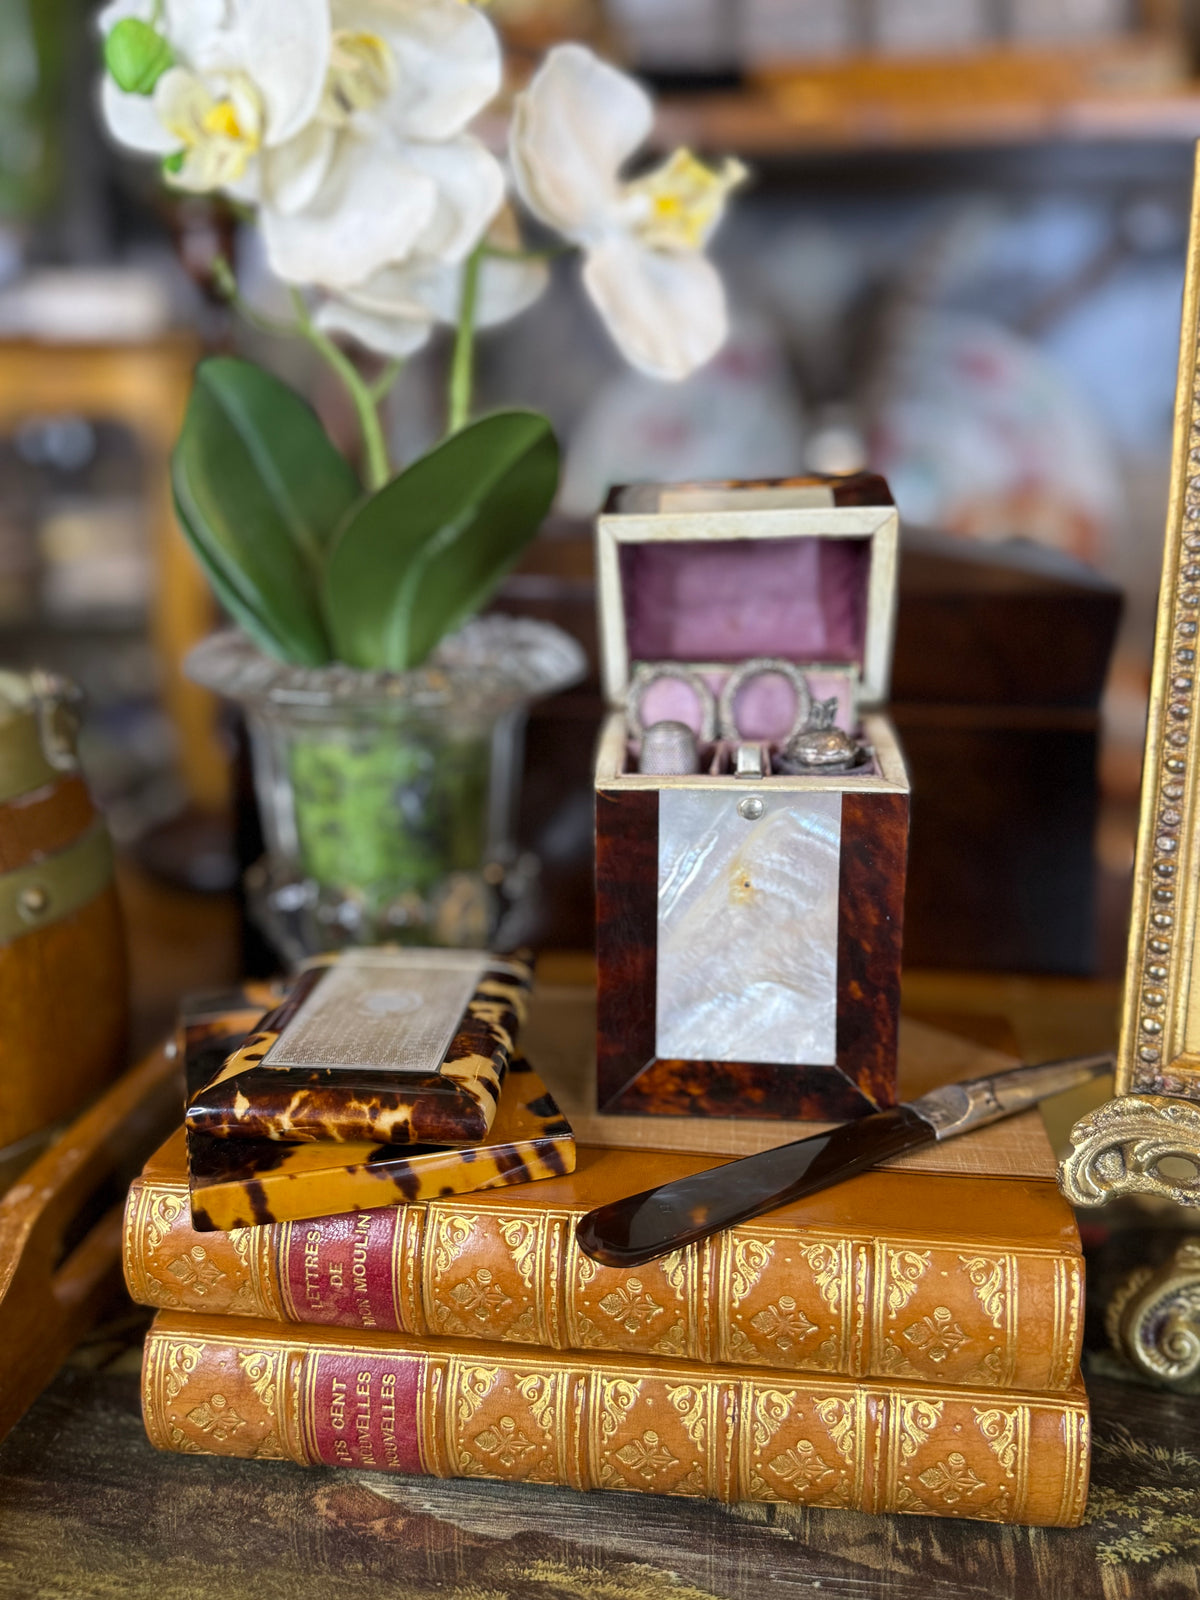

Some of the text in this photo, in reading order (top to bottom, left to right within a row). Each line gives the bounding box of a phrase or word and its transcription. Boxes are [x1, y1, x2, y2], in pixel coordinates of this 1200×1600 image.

[305, 1231, 324, 1308] LETTRES
[330, 1263, 343, 1287] DE
[352, 1214, 377, 1326] MON MOULIN
[331, 1377, 347, 1430] CENT
[357, 1371, 376, 1465] NOUVELLES
[381, 1373, 400, 1467] NOUVELLES
